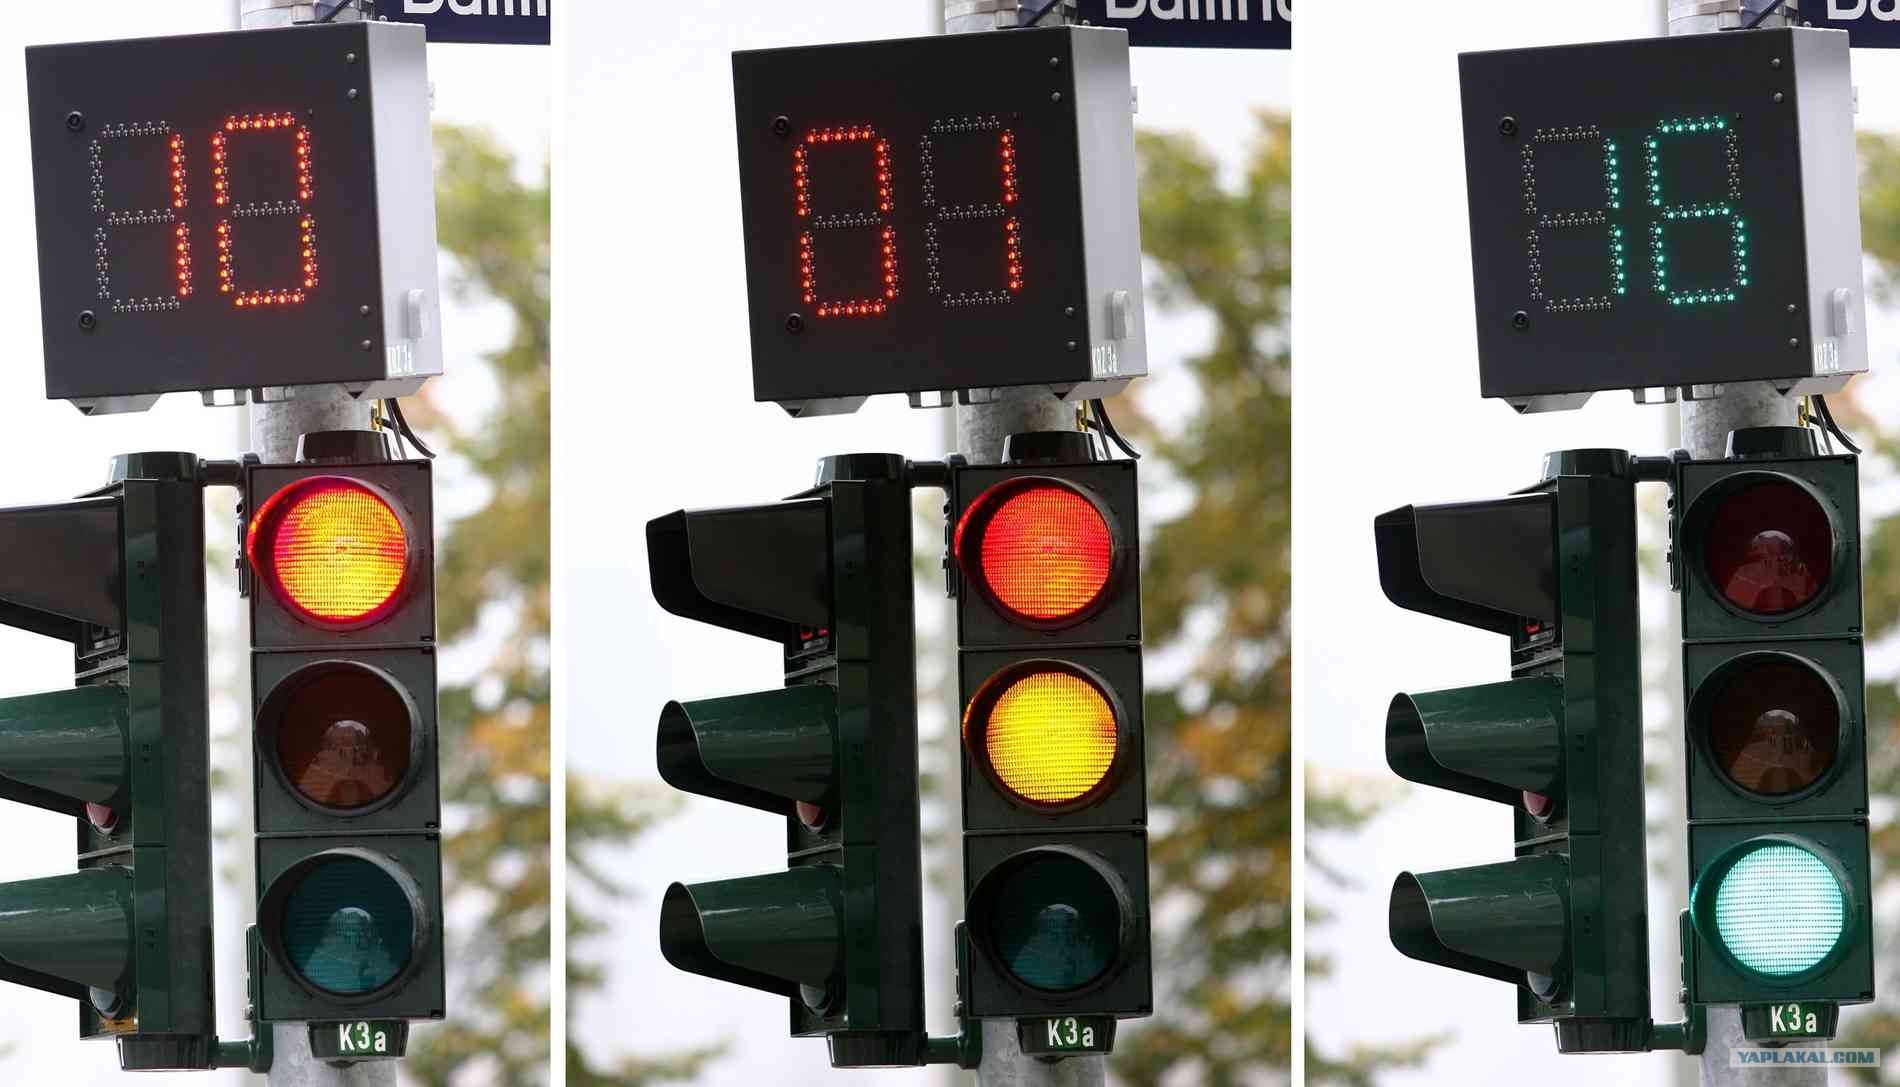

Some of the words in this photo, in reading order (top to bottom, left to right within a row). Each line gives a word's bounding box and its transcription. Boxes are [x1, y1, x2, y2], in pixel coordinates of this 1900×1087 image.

[168, 111, 320, 308] 10
[794, 124, 1023, 315] 01
[1602, 115, 1749, 305] 16
[339, 1021, 387, 1052] K3a
[1047, 1016, 1095, 1048] K3a
[1770, 1003, 1818, 1033] K3a
